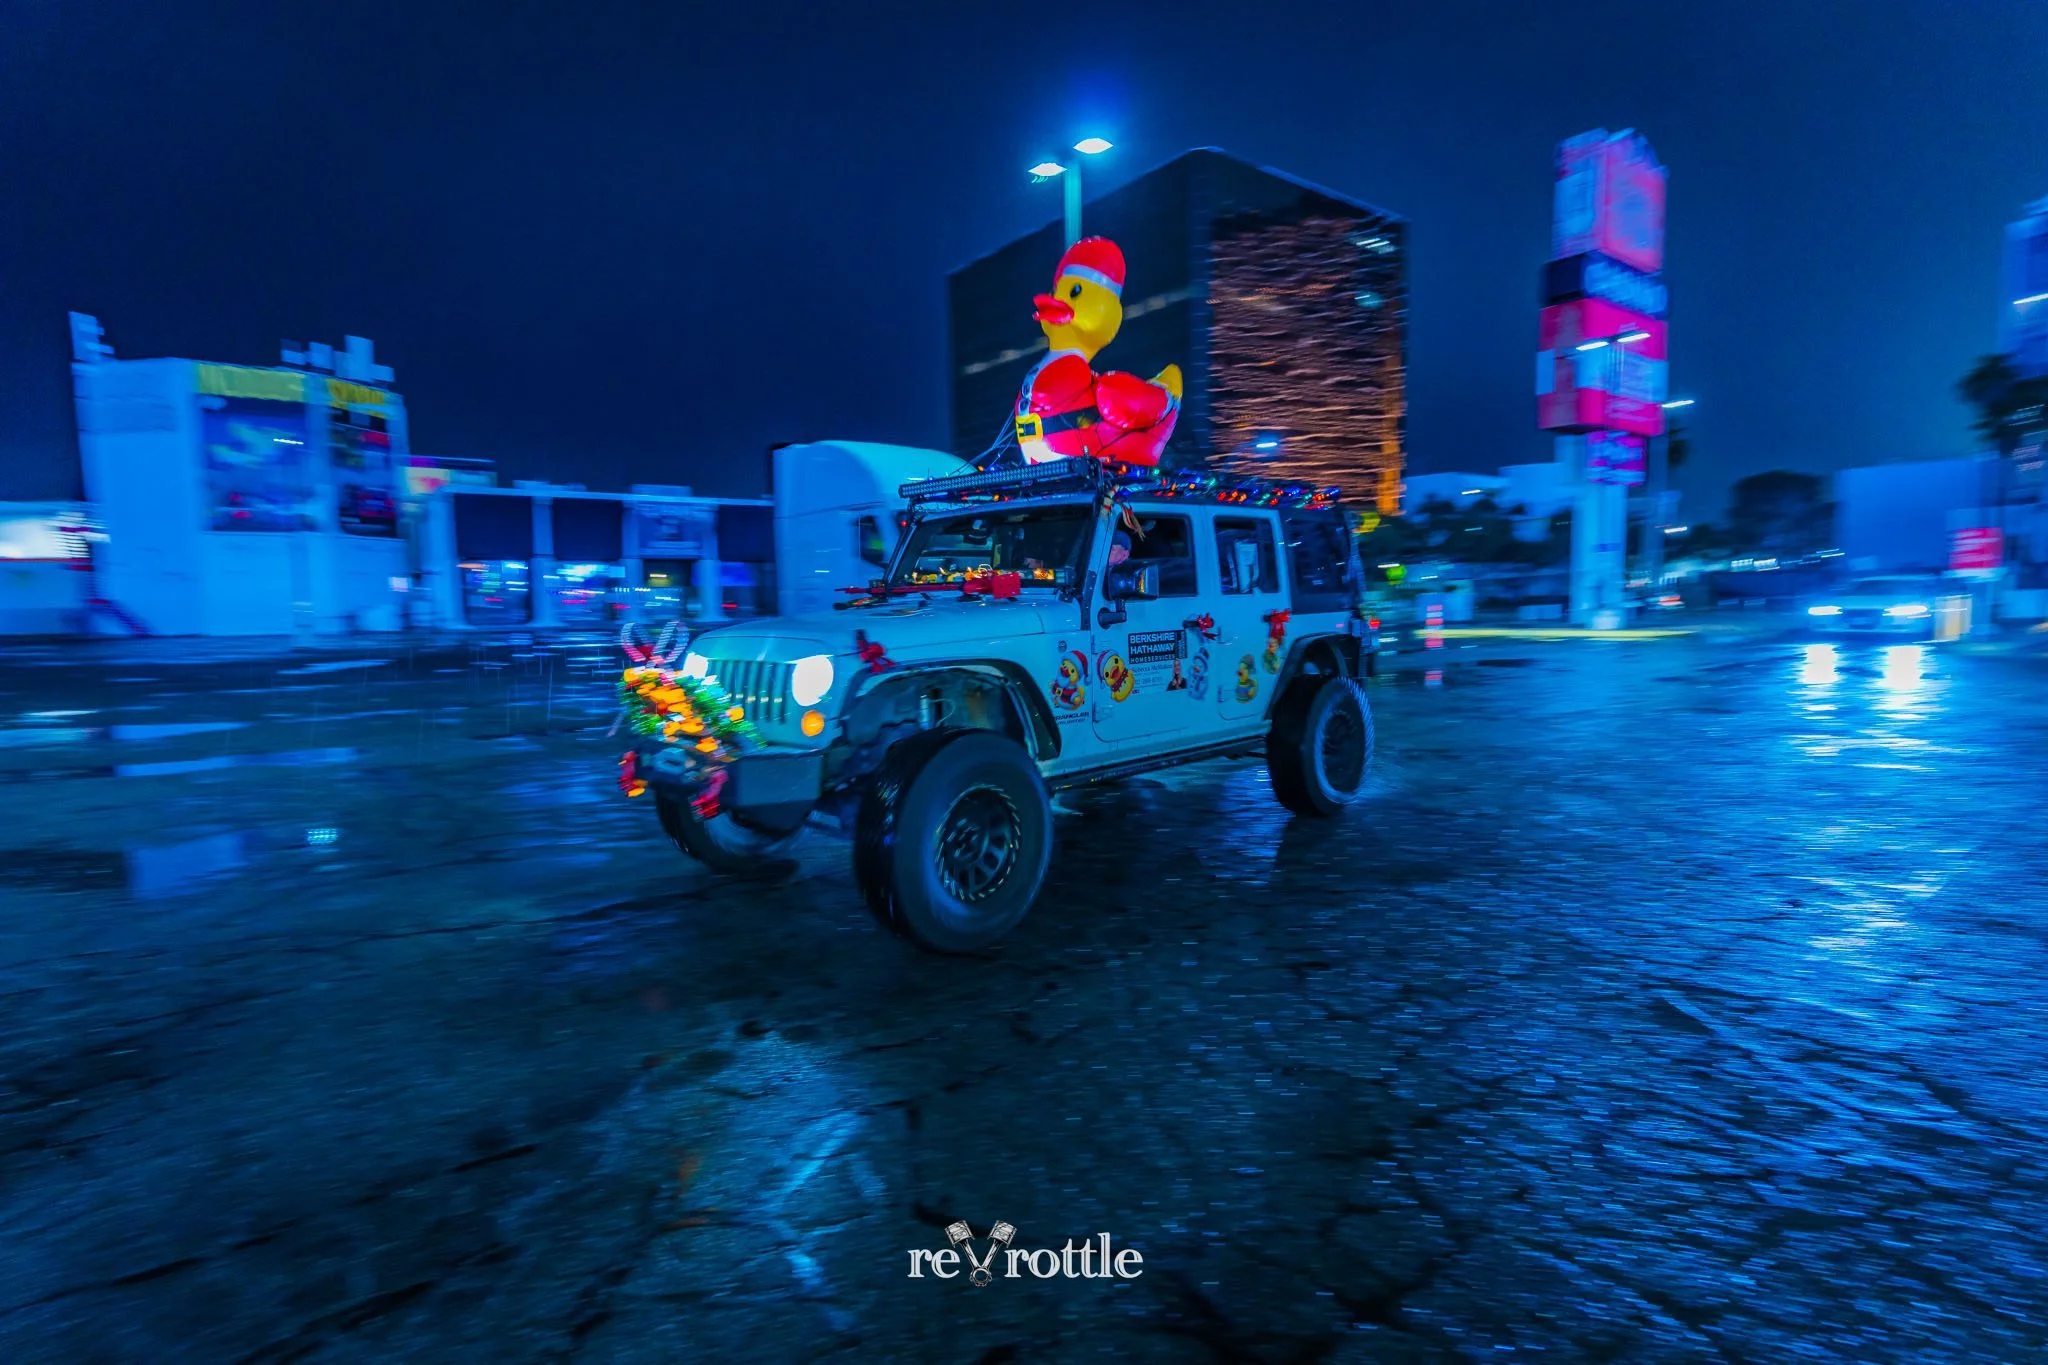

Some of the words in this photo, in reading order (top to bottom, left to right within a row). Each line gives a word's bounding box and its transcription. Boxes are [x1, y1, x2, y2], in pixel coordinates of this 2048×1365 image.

[1130, 632, 1175, 644] BERKSHIRE
[1130, 643, 1175, 655] HATHAWAY
[1130, 654, 1175, 663] HOMESERVICES
